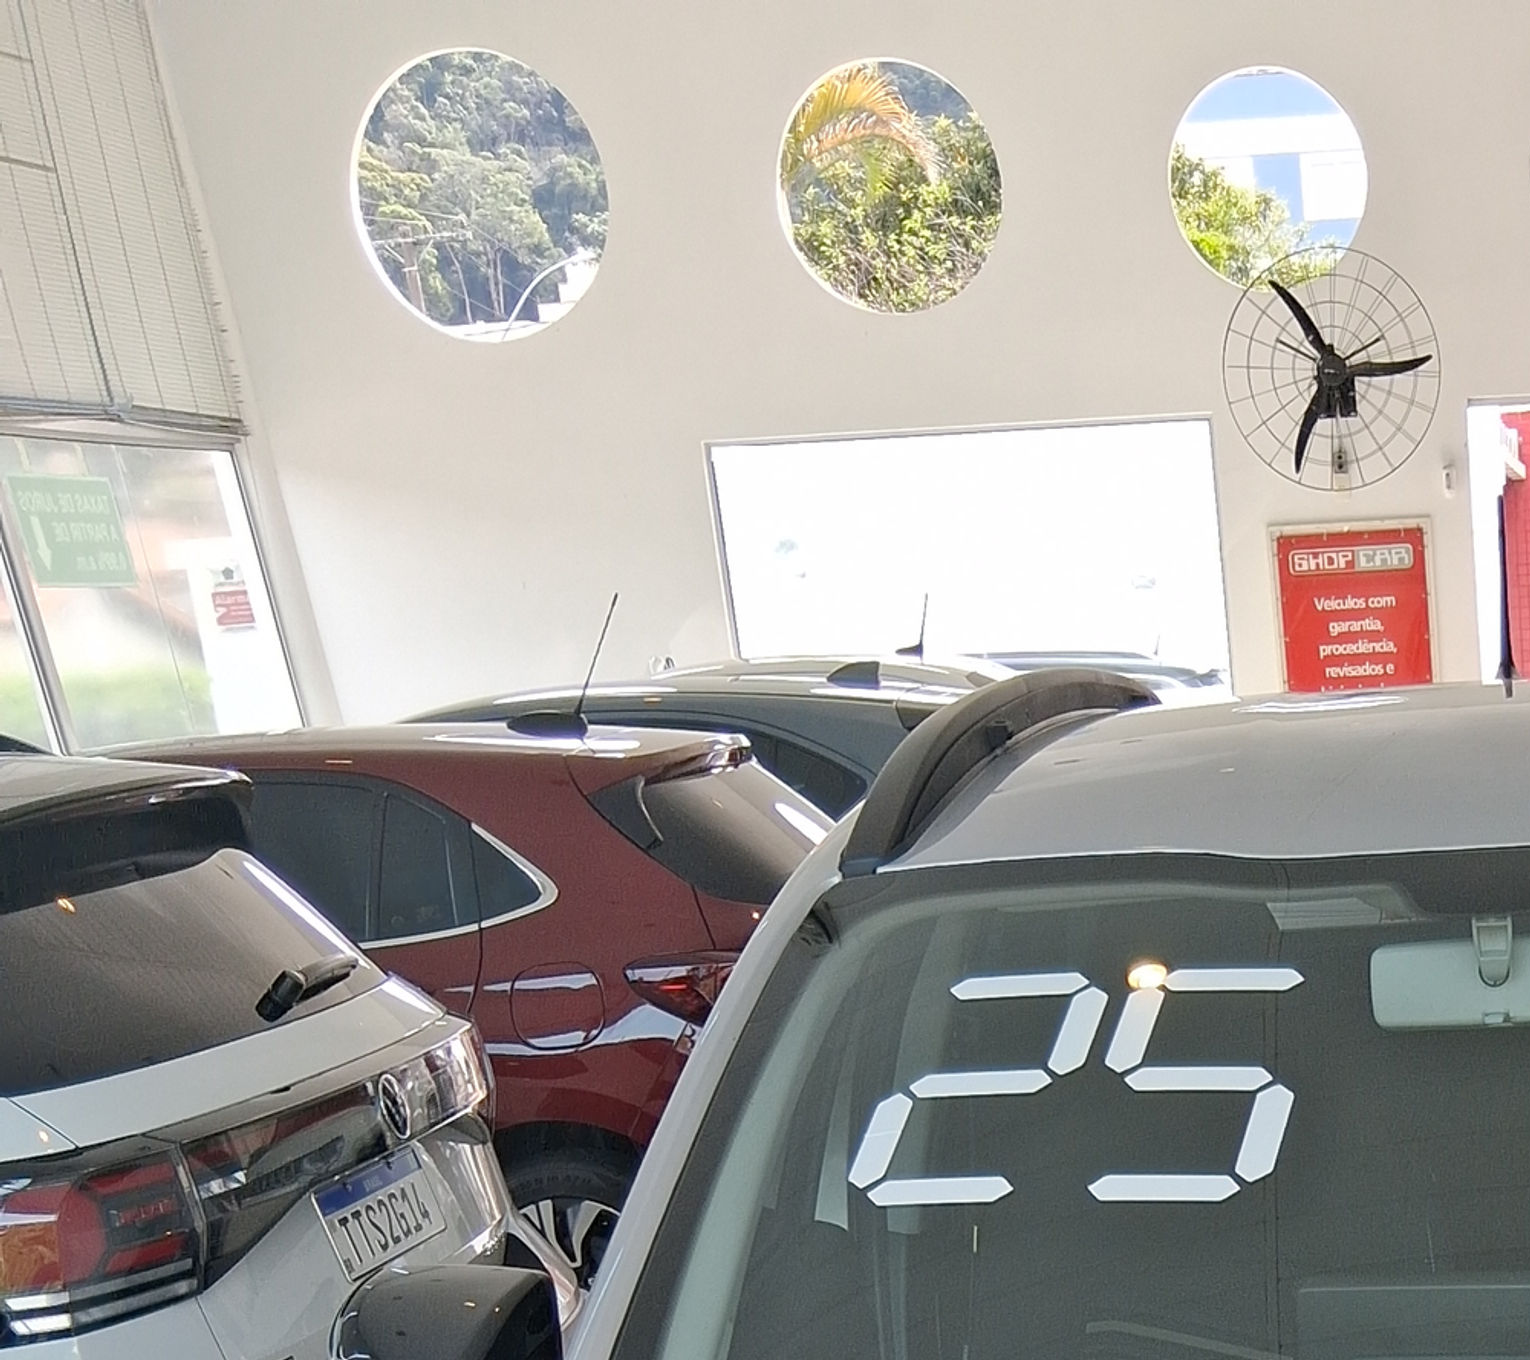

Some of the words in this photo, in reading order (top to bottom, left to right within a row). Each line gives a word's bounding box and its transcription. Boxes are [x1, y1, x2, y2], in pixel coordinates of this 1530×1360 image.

[1293, 551, 1353, 572] SHOP
[1358, 548, 1409, 568] CAR
[1313, 594, 1366, 611] Veículos
[1367, 595, 1396, 608] com
[1328, 616, 1384, 637] garantia,
[1318, 638, 1398, 660] procedência,
[1324, 661, 1384, 678] revisados
[1386, 662, 1395, 674] e
[848, 966, 1306, 1208] 25
[336, 1181, 433, 1265] TTS2G14
